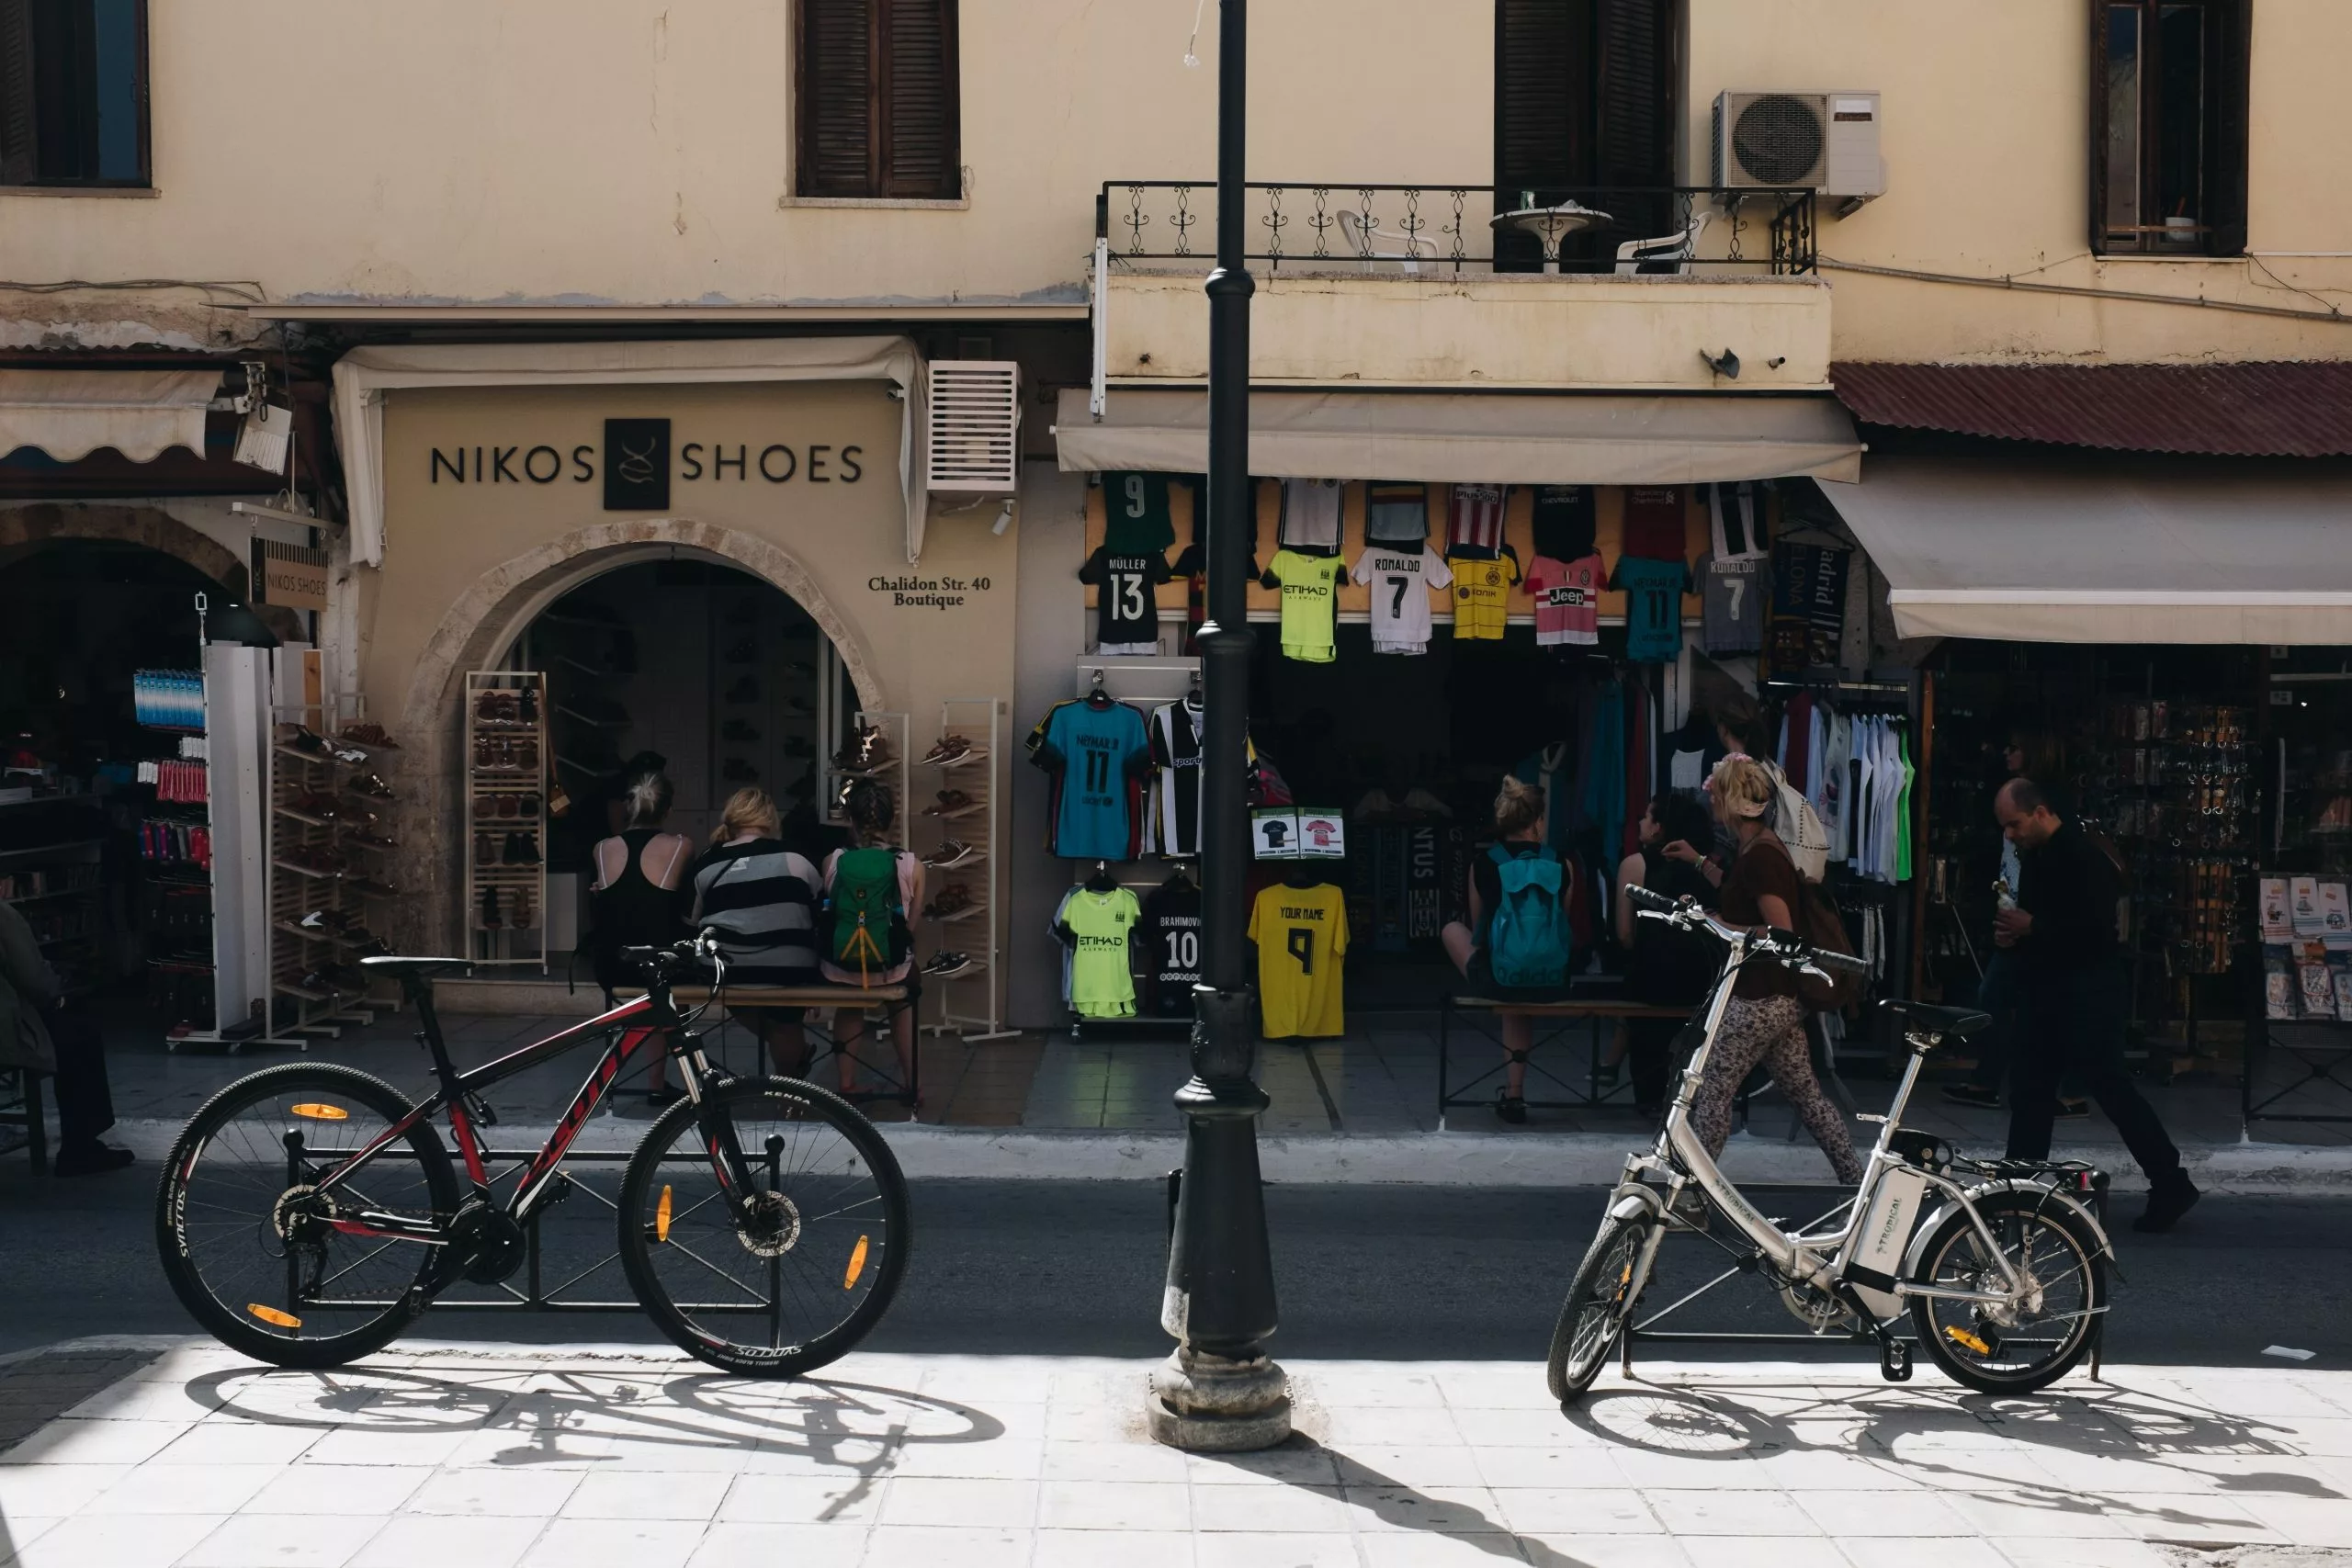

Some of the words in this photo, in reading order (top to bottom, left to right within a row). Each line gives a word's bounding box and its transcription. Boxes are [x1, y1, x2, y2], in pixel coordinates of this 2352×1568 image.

[431, 445, 594, 483] NIKOS
[681, 443, 863, 484] SHOES
[1125, 474, 1146, 518] 9
[1109, 555, 1147, 570] MÜLLER
[1374, 558, 1420, 572] RONALDO
[267, 572, 295, 592] NIKOS
[298, 577, 326, 596] SHOES
[868, 576, 938, 591] Chalidon
[942, 577, 967, 591] Str.
[971, 577, 990, 591] 40
[1815, 548, 1838, 606] adrid
[1110, 573, 1145, 621] 13
[1283, 584, 1328, 596] ETIHAD
[1386, 575, 1408, 619] 7
[1550, 588, 1584, 605] Jeep
[1723, 579, 1745, 621] 7
[894, 592, 965, 611] Boutique
[1280, 906, 1302, 919] YOUR
[1303, 908, 1325, 920] NAME
[1079, 936, 1123, 946] ETIHAD
[1165, 931, 1198, 968] 10
[763, 1090, 810, 1105] KENDA
[1878, 1197, 1903, 1246] TROPICAL
